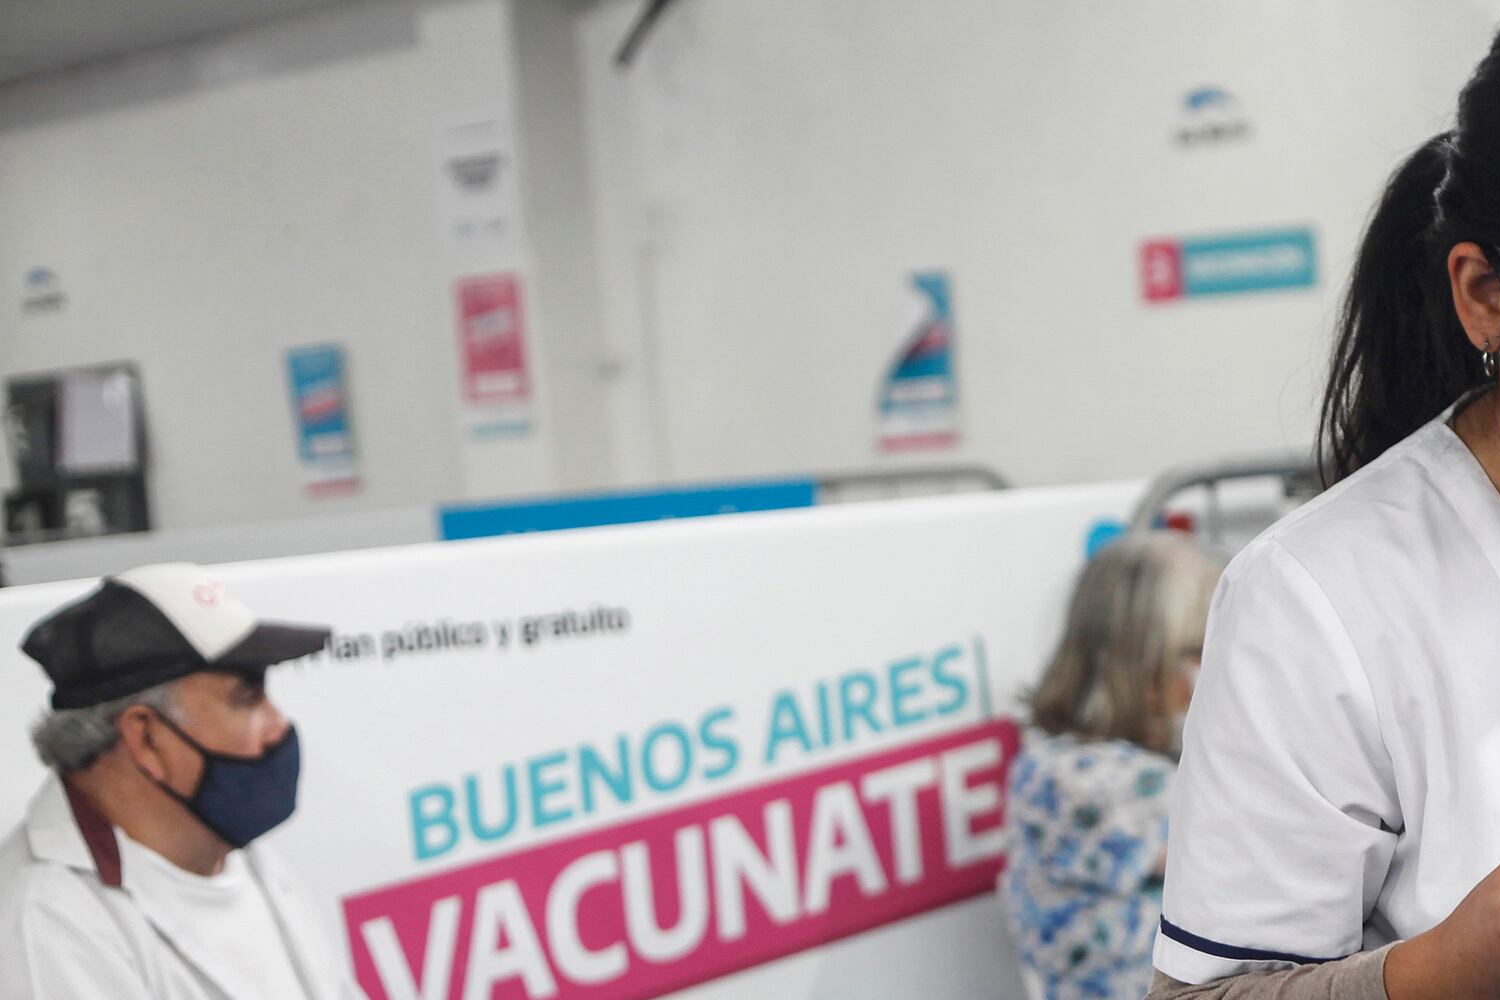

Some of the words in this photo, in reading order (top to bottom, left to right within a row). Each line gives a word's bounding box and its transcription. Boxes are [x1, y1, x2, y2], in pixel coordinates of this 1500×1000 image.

[518, 604, 630, 648] gratuito
[408, 707, 740, 861] BUENOS
[763, 647, 969, 763] AIRES
